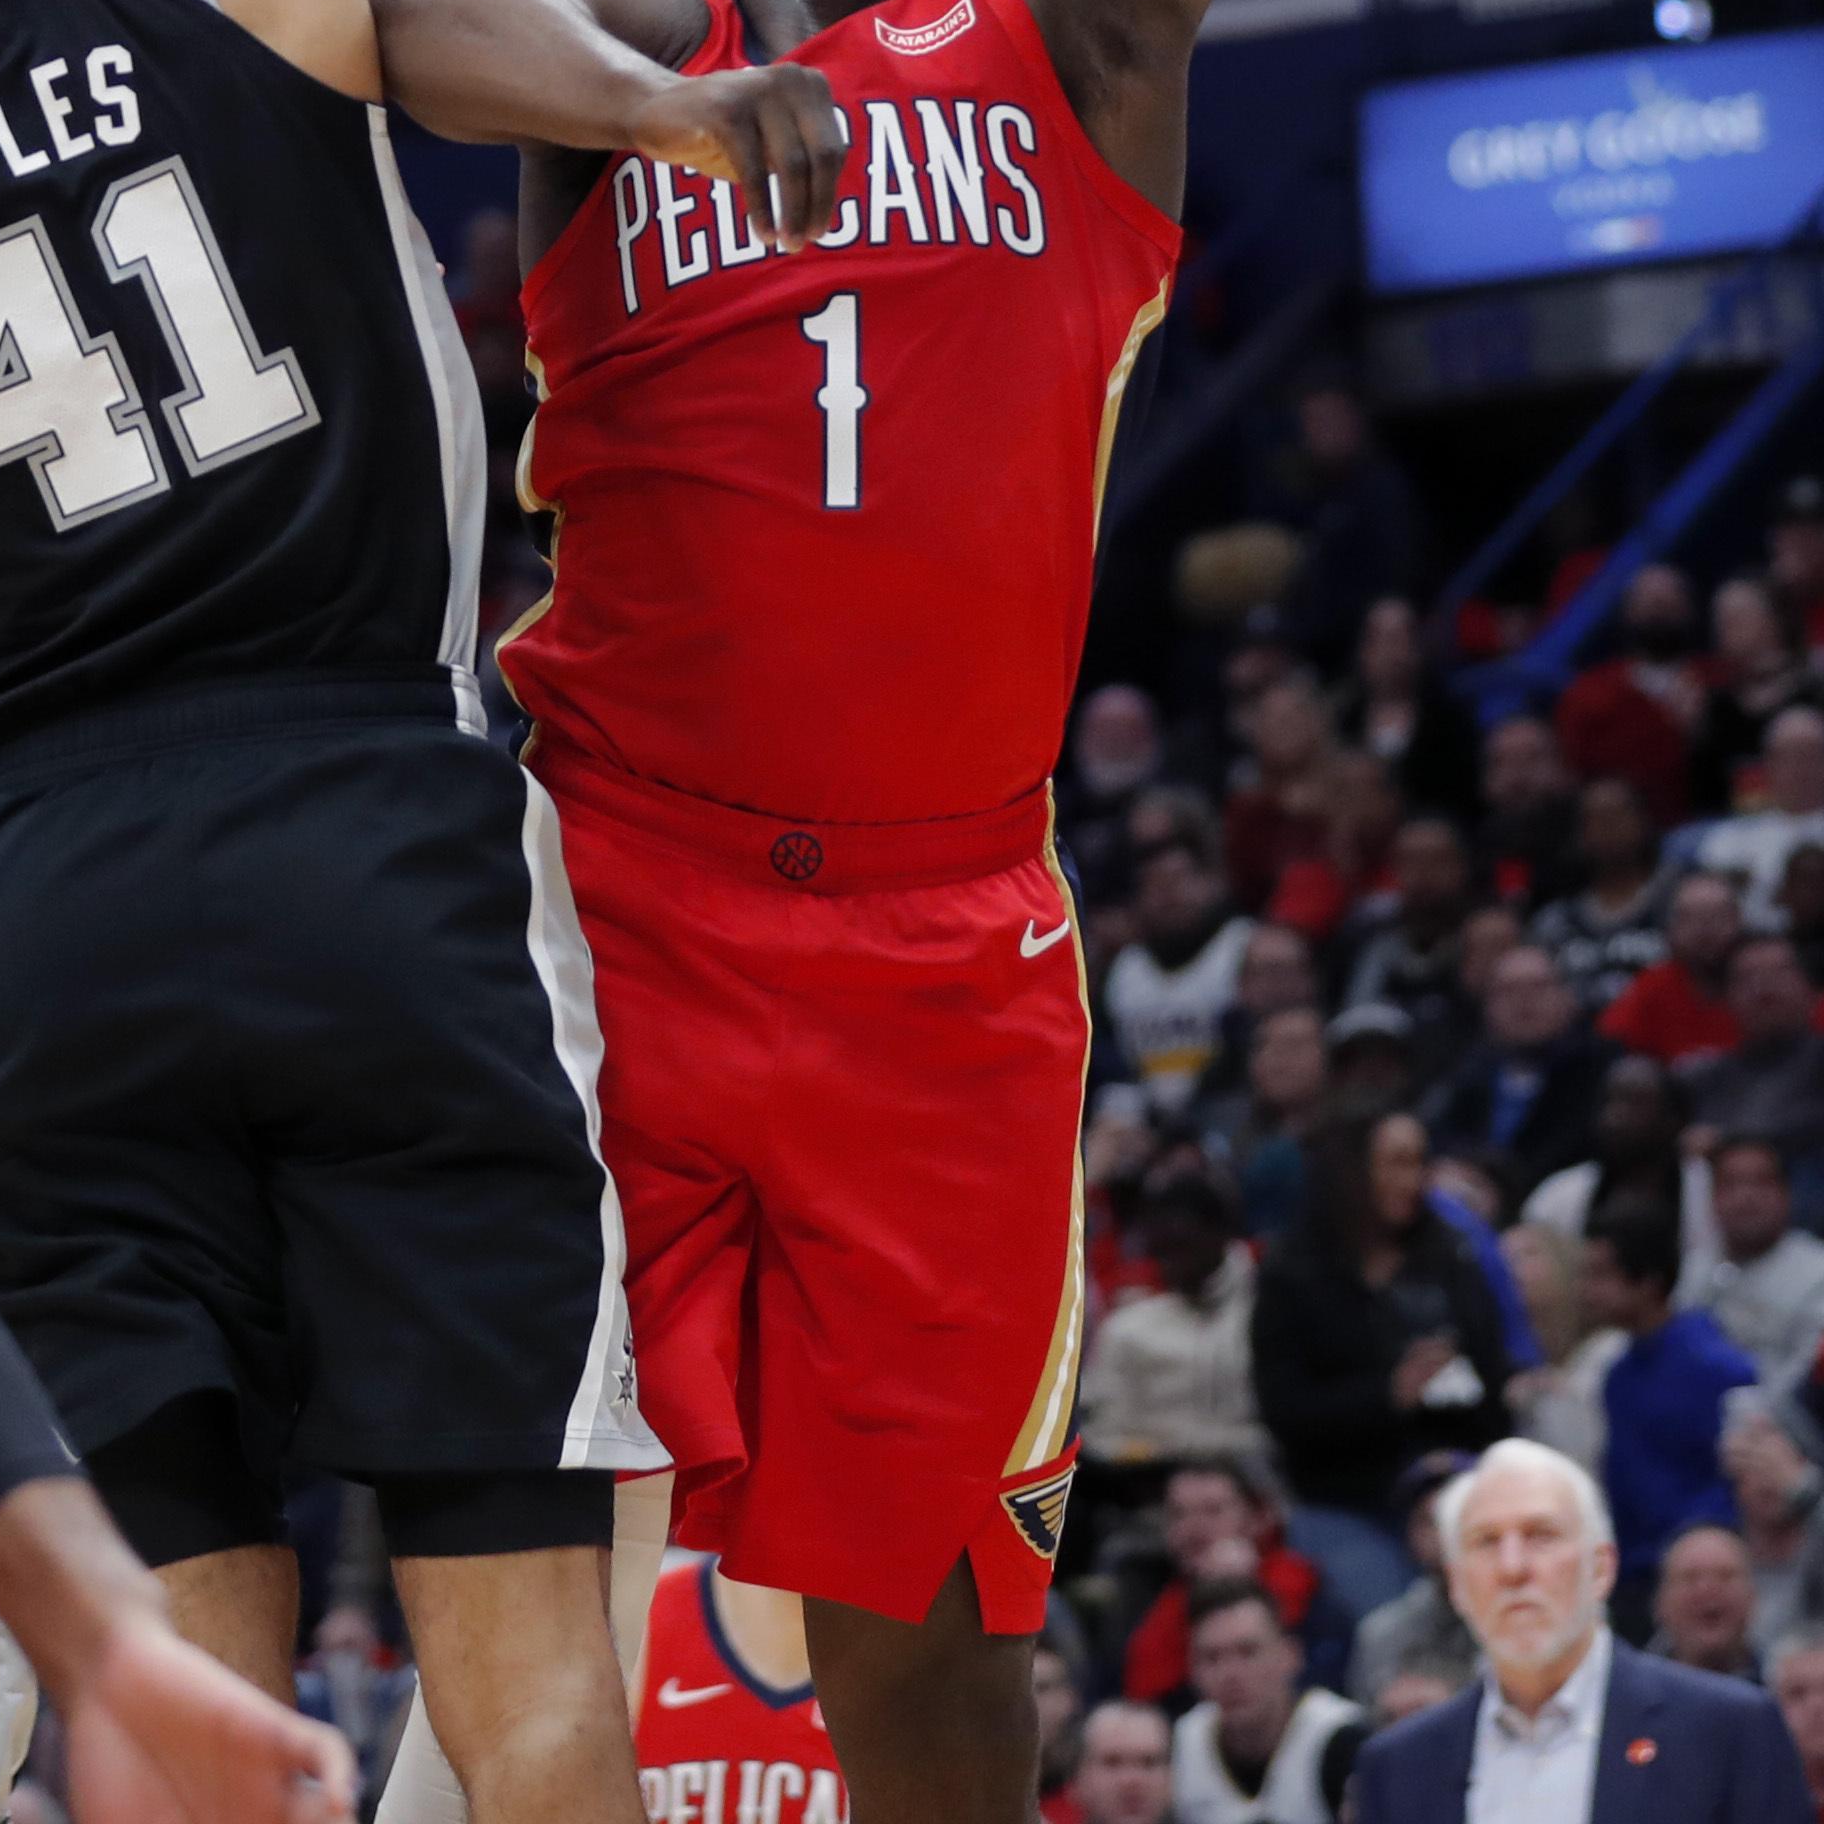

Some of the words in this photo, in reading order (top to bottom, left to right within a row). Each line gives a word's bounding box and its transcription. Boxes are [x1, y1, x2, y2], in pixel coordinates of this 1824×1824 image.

[612, 97, 1048, 315] PELCANS
[798, 289, 870, 512] 1
[638, 1758, 851, 1824] PELICA
